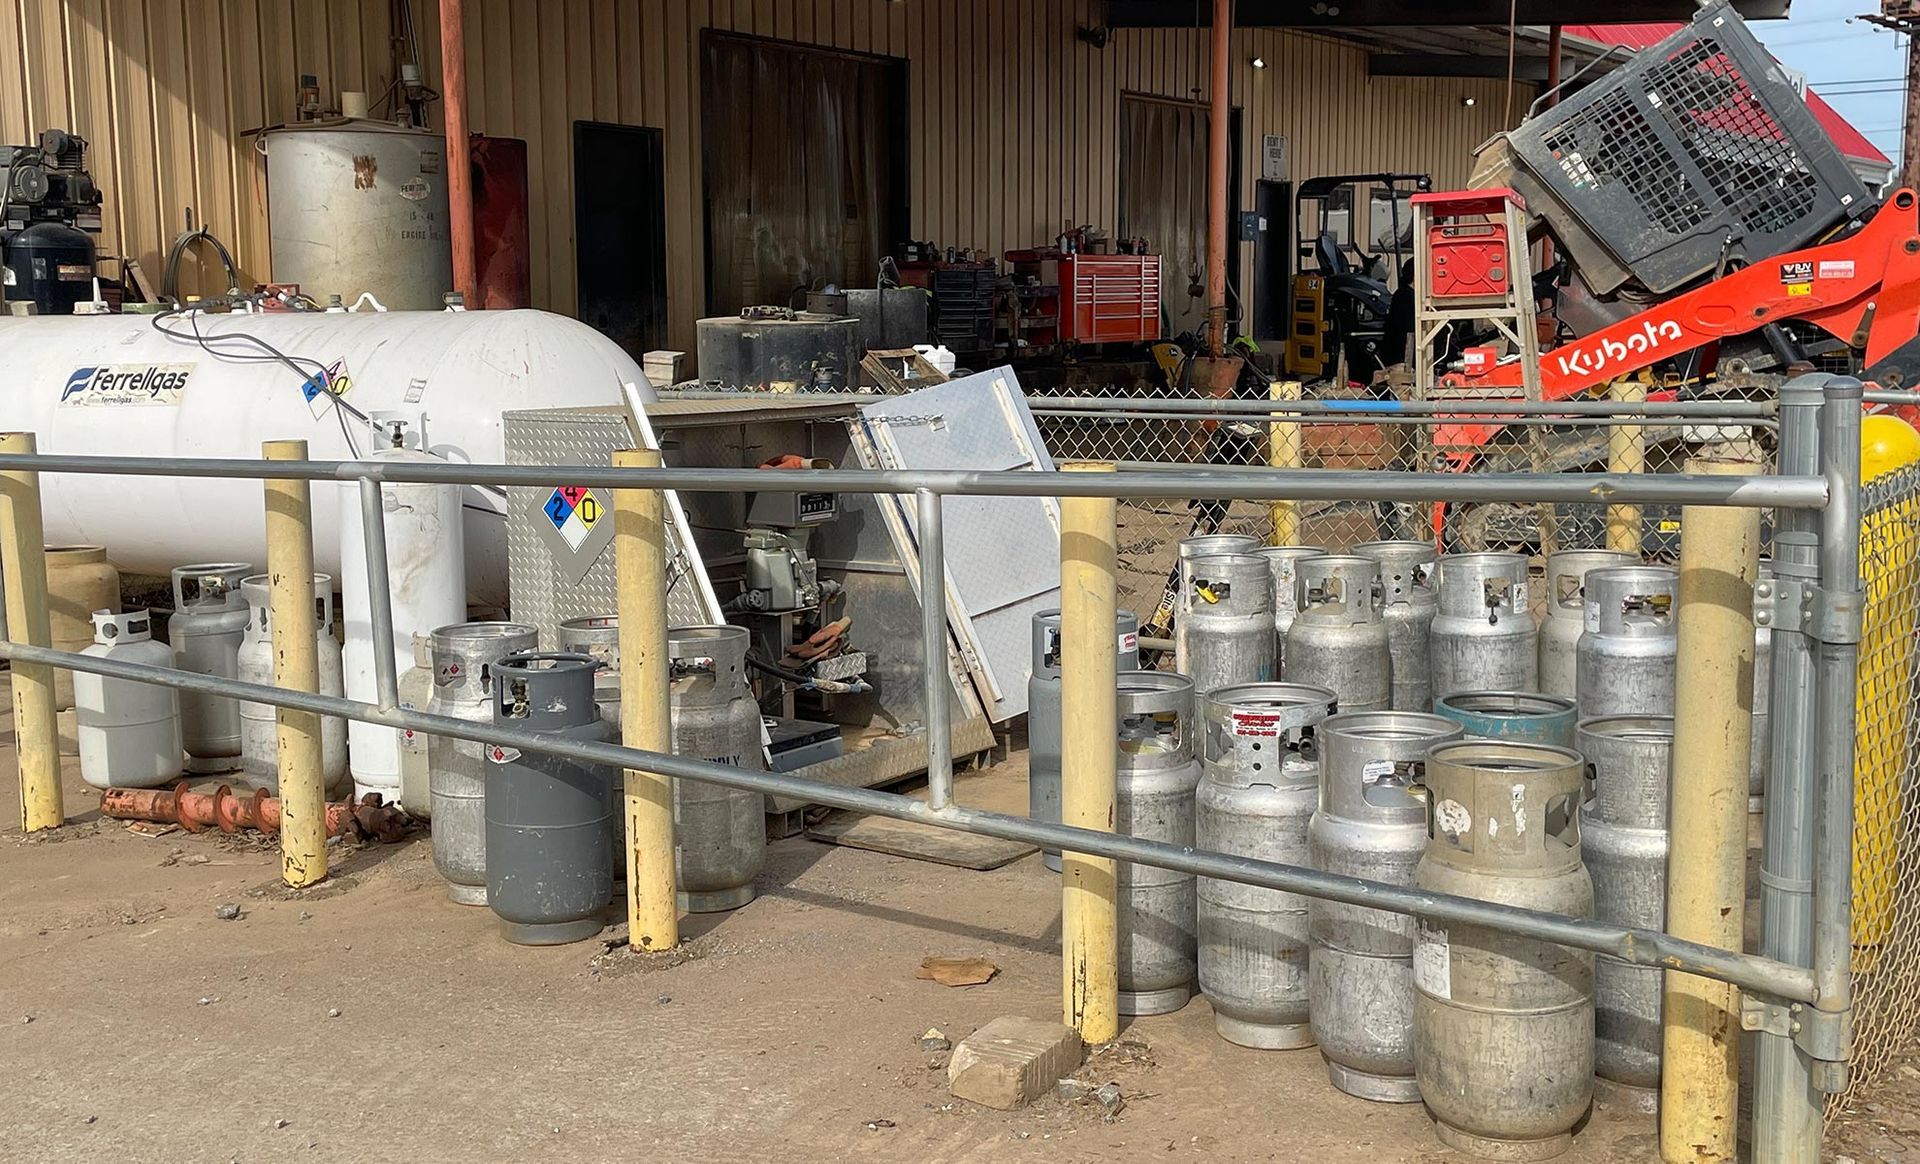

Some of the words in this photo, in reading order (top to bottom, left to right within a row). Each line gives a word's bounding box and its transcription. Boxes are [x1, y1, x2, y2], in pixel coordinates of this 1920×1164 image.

[1558, 320, 1683, 376] Kubota
[91, 366, 190, 399] Ferrellgas
[327, 361, 342, 379] 4
[565, 487, 578, 501] 4
[553, 496, 564, 521] 2
[582, 497, 596, 523] 0
